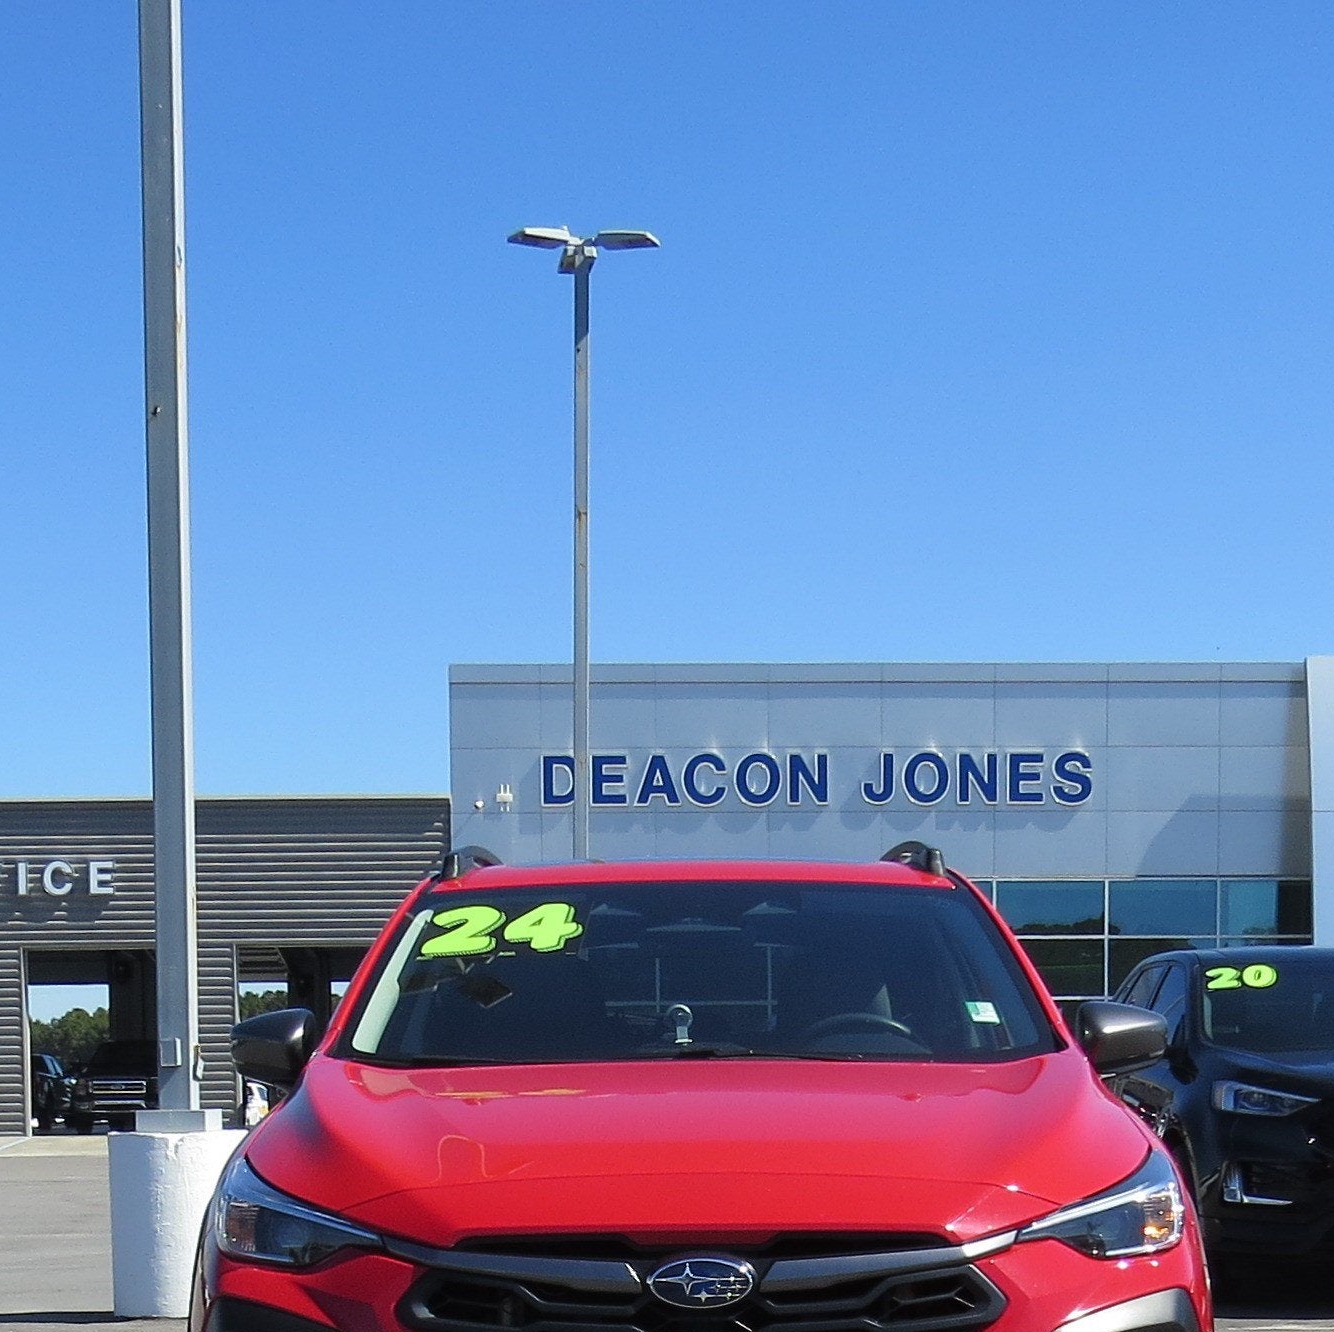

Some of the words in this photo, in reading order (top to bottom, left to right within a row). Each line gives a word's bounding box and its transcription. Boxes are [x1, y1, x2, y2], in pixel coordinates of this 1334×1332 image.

[541, 752, 829, 807] DEACON
[860, 751, 1094, 806] JONES
[420, 901, 585, 957] 24
[1205, 963, 1279, 990] 20
